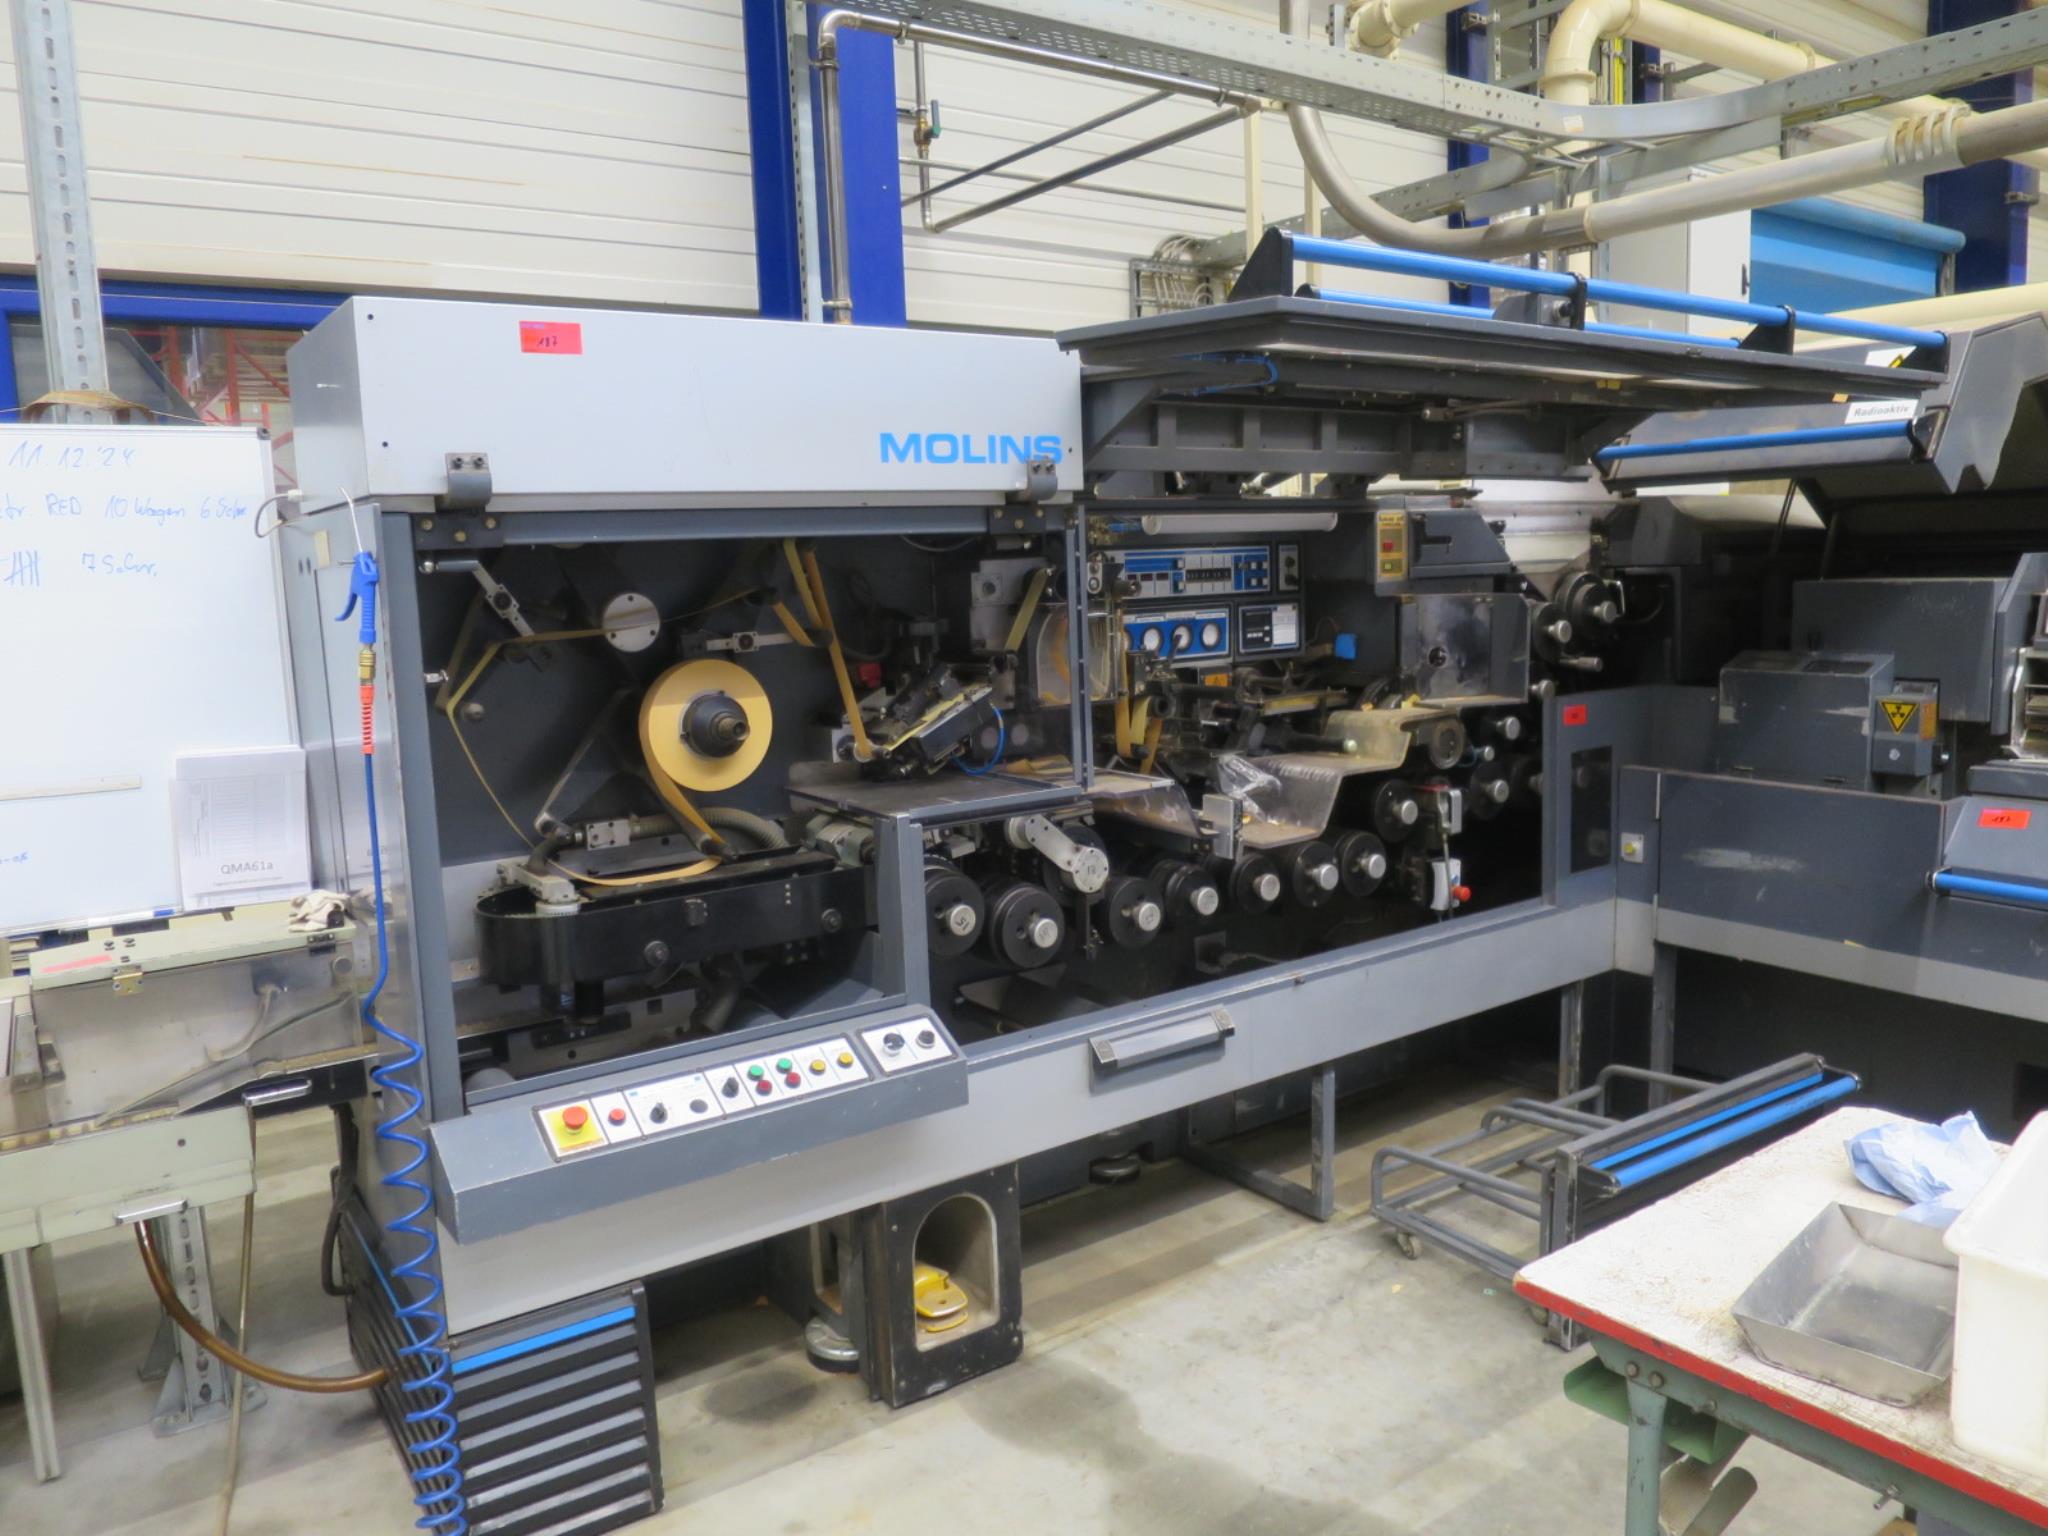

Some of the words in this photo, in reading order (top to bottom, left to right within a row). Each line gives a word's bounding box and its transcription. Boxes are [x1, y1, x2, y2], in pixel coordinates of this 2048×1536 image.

[1854, 405, 1910, 418] Radioaktiv
[880, 432, 1063, 465] MOLINS
[45, 491, 82, 517] RED
[220, 861, 274, 876] QMA61a
